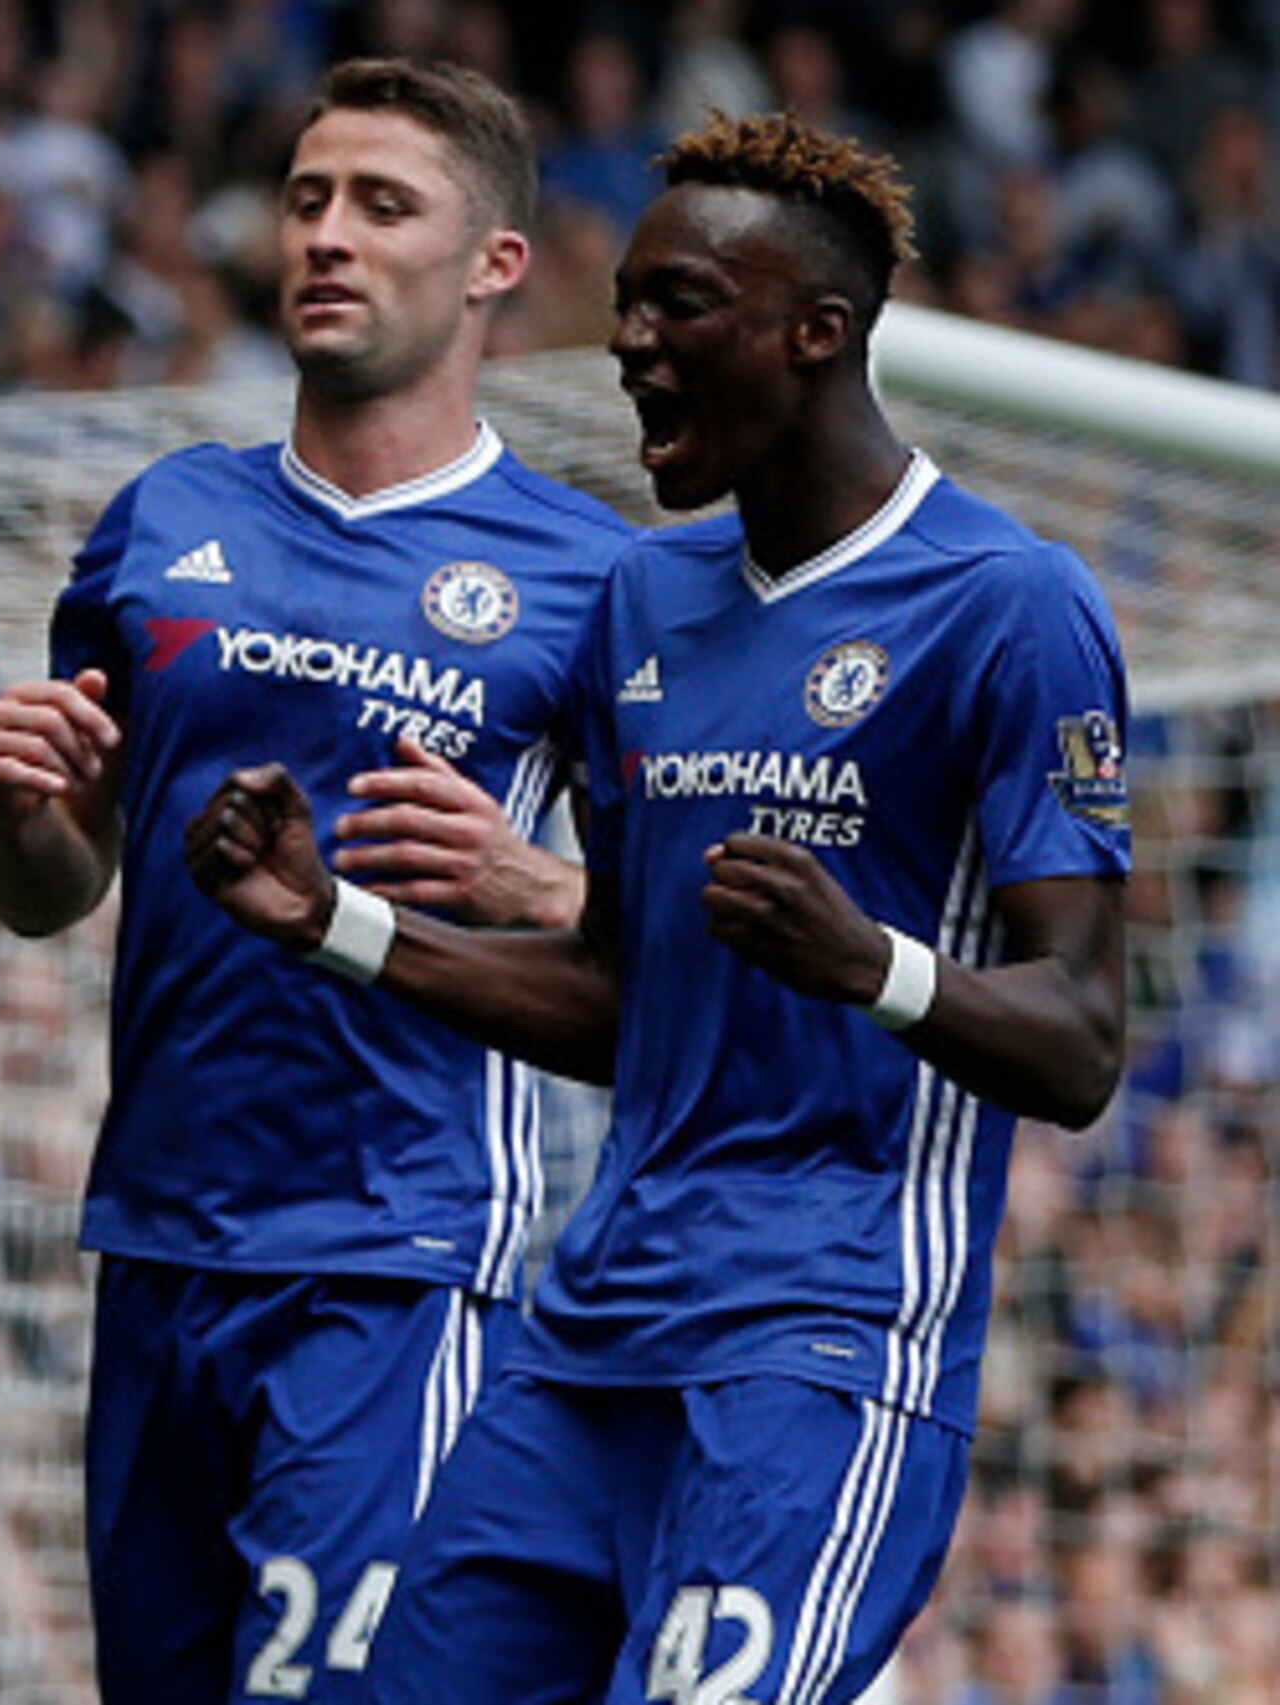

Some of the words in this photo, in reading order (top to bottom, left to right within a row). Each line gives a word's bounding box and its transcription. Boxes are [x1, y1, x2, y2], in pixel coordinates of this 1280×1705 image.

[216, 626, 485, 728] YOKOHAMA
[356, 699, 477, 758] TYRES
[640, 751, 867, 807] YOKOHAMA
[747, 807, 866, 846] TYRES
[244, 1554, 400, 1697] 24
[646, 1585, 775, 1705] 42
